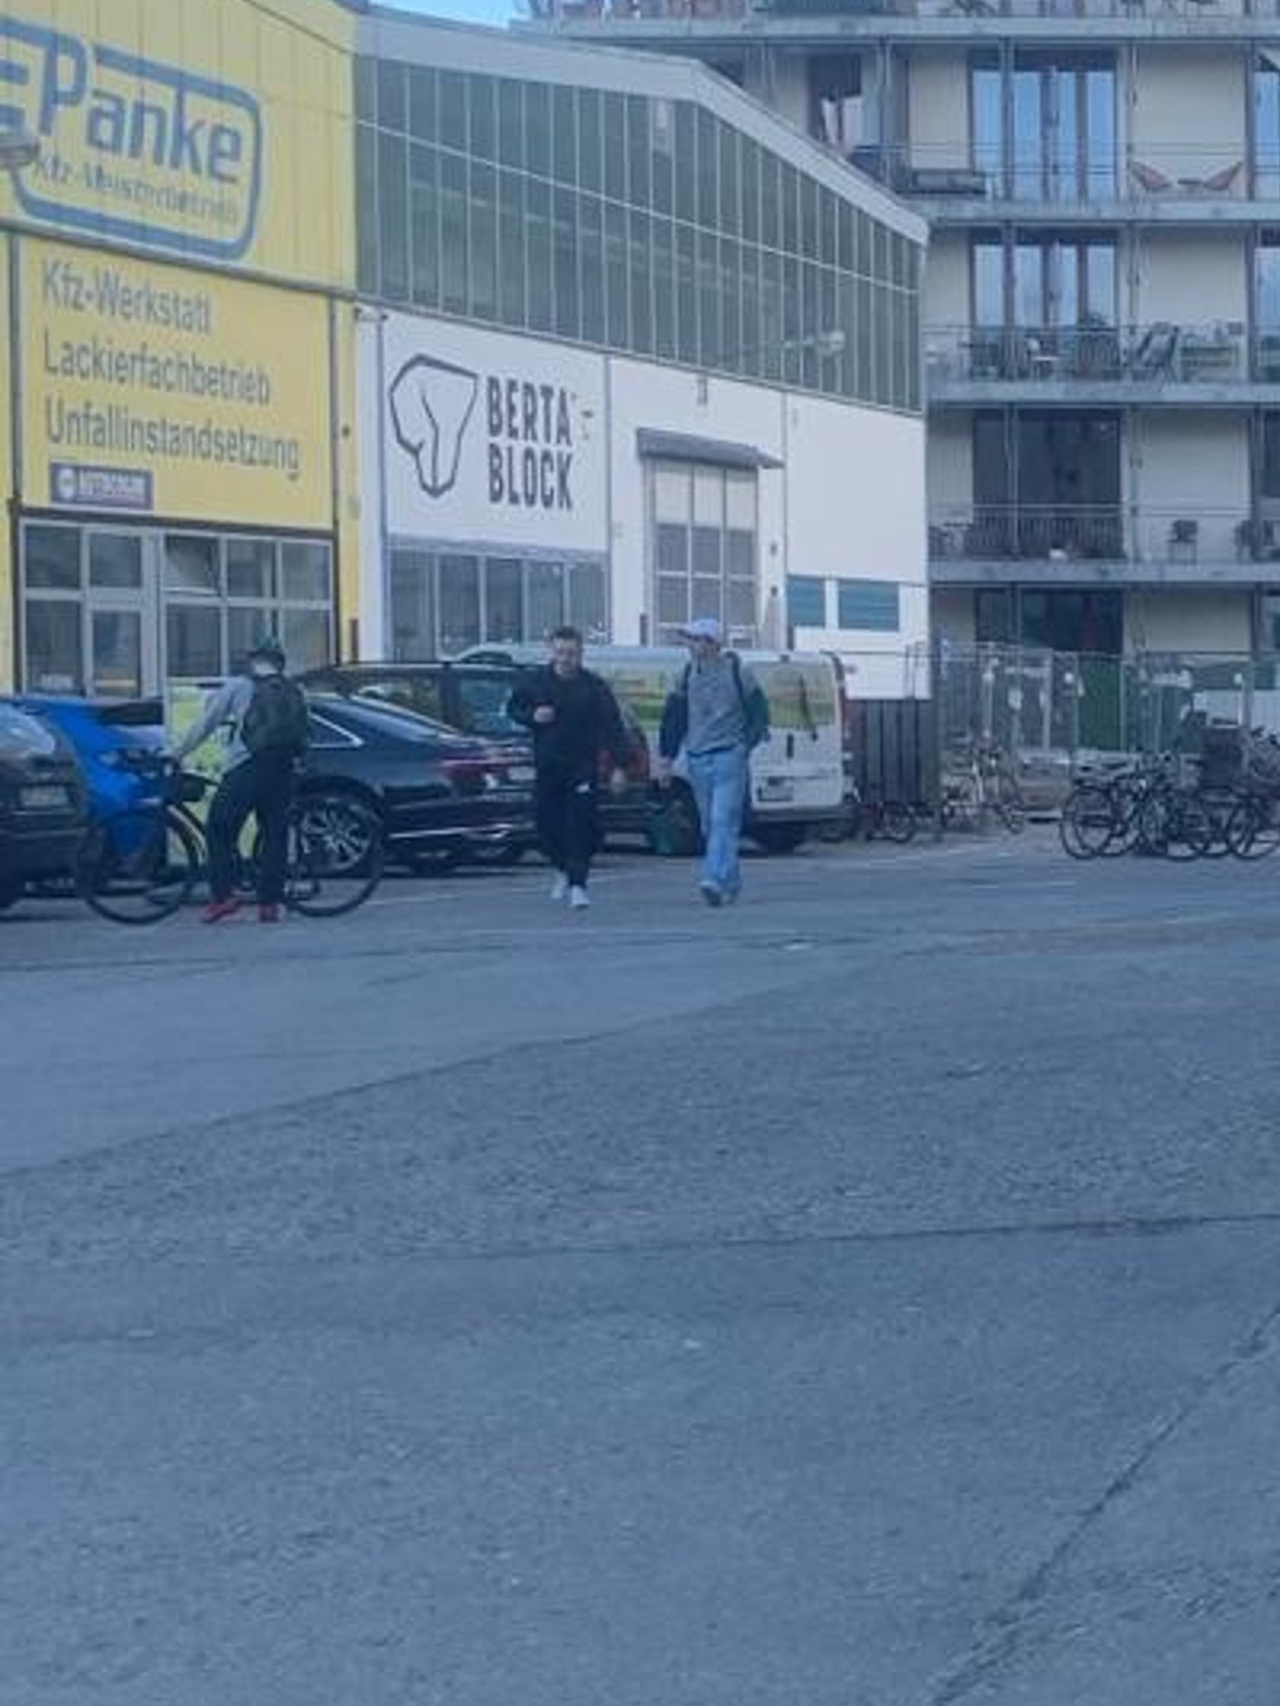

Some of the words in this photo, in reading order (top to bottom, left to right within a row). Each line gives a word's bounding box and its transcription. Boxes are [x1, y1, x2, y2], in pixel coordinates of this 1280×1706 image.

[44, 327, 270, 405] Lackierfachbetrieb
[44, 394, 299, 481] Unfallinstandsetzung
[487, 375, 572, 447] BERTA
[488, 443, 573, 511] BLOCK
